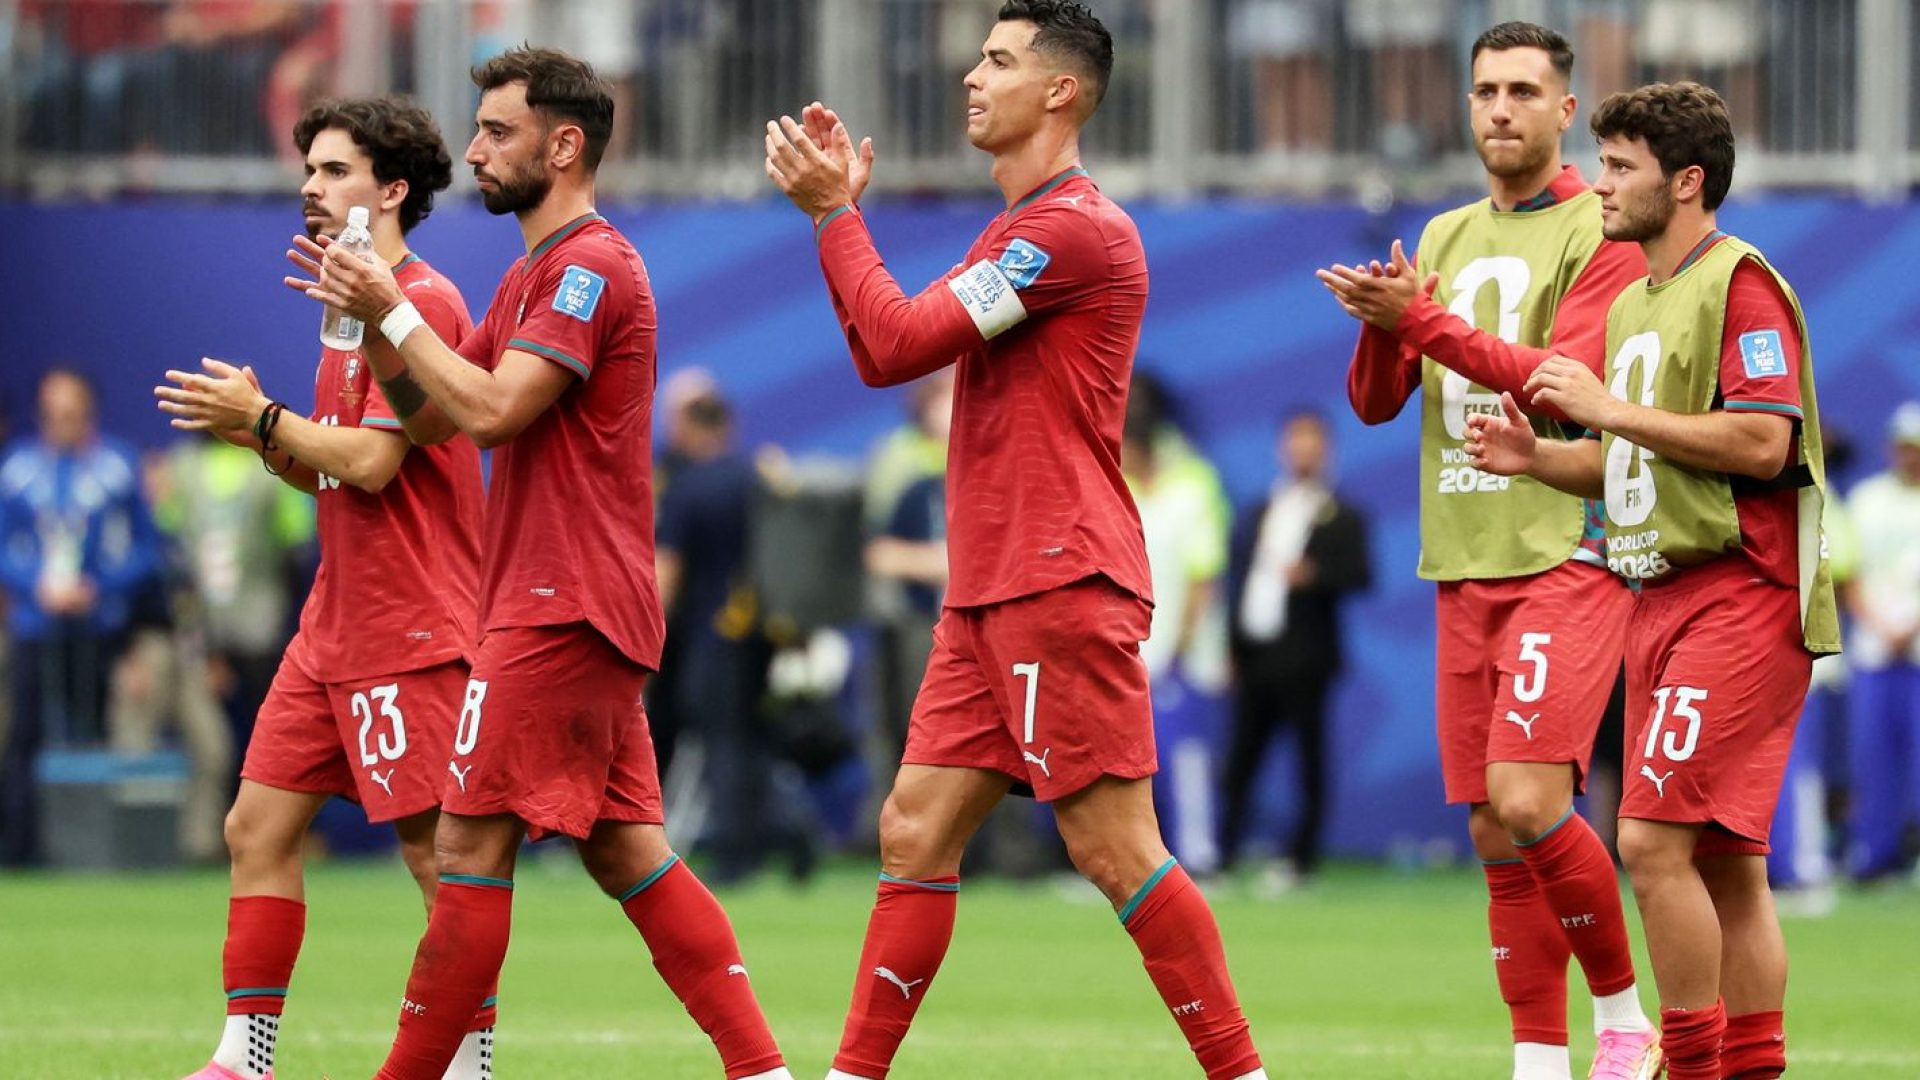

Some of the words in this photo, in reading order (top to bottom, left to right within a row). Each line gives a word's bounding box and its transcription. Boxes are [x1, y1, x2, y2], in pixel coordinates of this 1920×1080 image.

[1441, 447, 1471, 464] WOR
[1625, 488, 1640, 508] FI
[1012, 661, 1039, 744] 7
[1513, 632, 1551, 703] 5
[351, 682, 407, 768] 23
[454, 678, 488, 756] 8
[1643, 686, 1708, 761] 15
